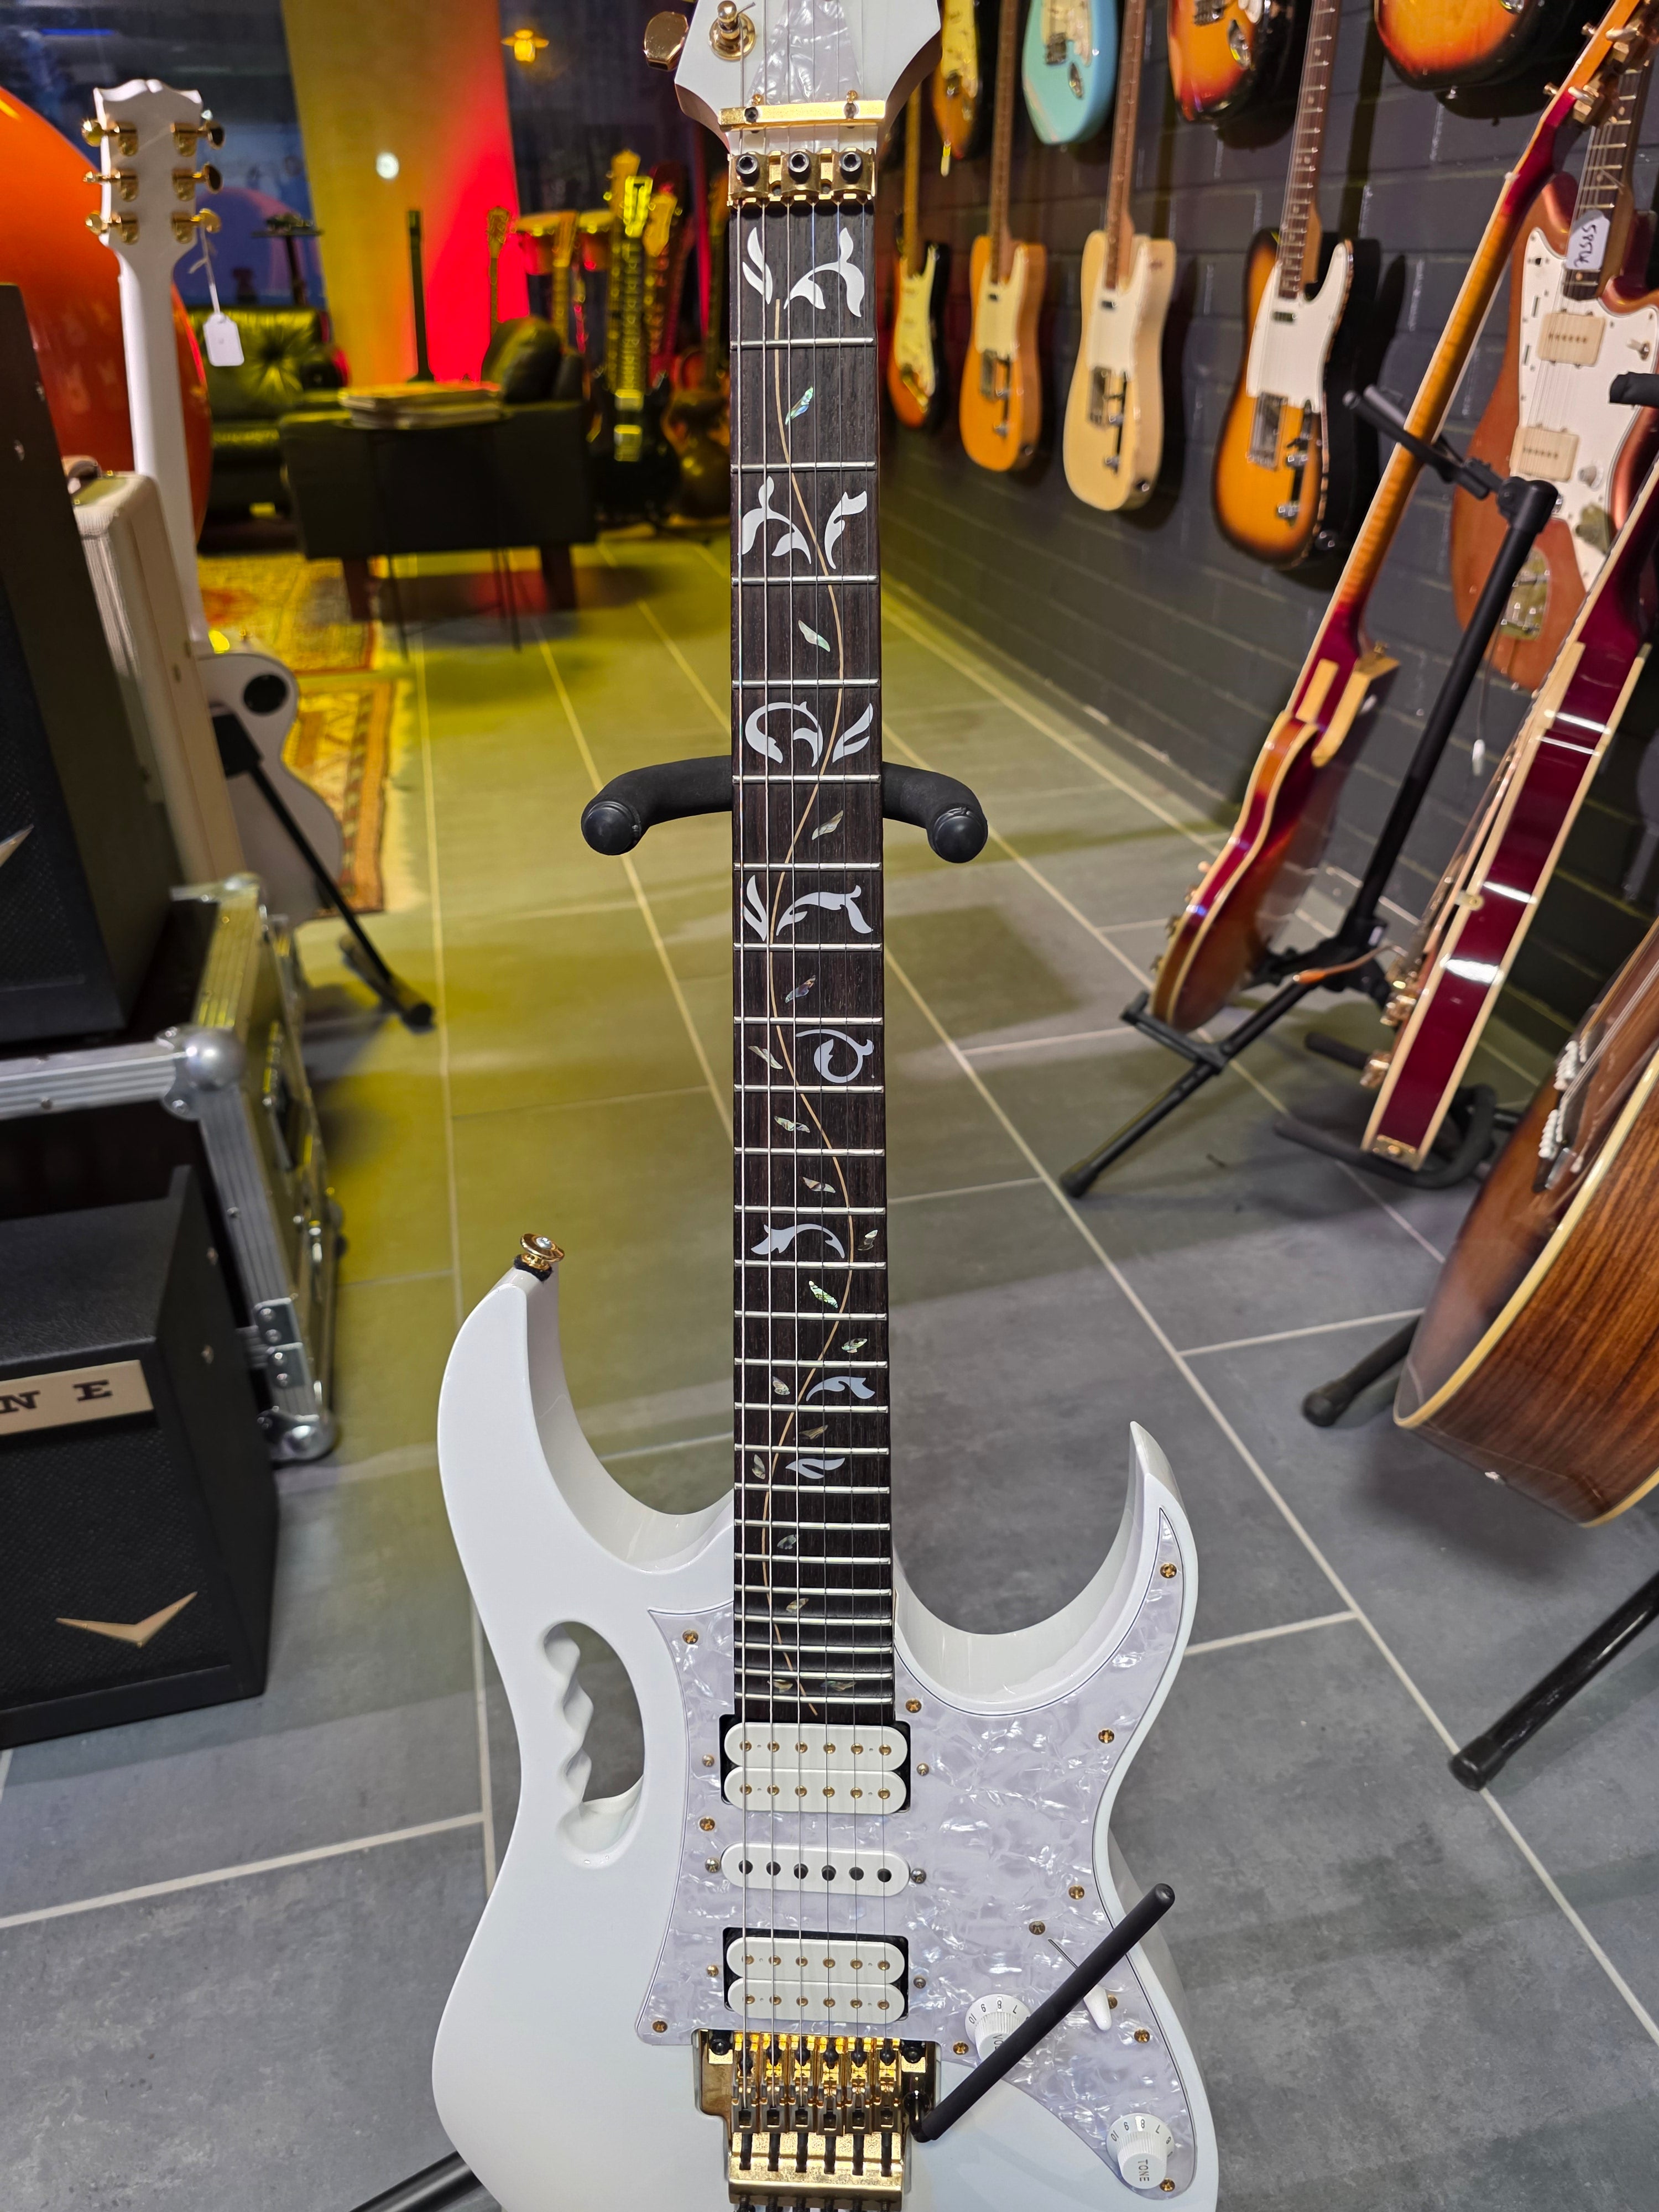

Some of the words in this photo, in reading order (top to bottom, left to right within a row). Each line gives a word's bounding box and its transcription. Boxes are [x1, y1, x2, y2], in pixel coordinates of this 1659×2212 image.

[980, 2004, 987, 2013] 9
[997, 2000, 1002, 2009] 8
[1013, 2005, 1018, 2014] 7
[968, 2013, 977, 2024] 10
[1124, 2121, 1129, 2131] 9
[1140, 2119, 1145, 2128] 8
[1155, 2124, 1161, 2134] 7
[1110, 2130, 1119, 2142] 10
[1138, 2159, 1150, 2182] TONE
